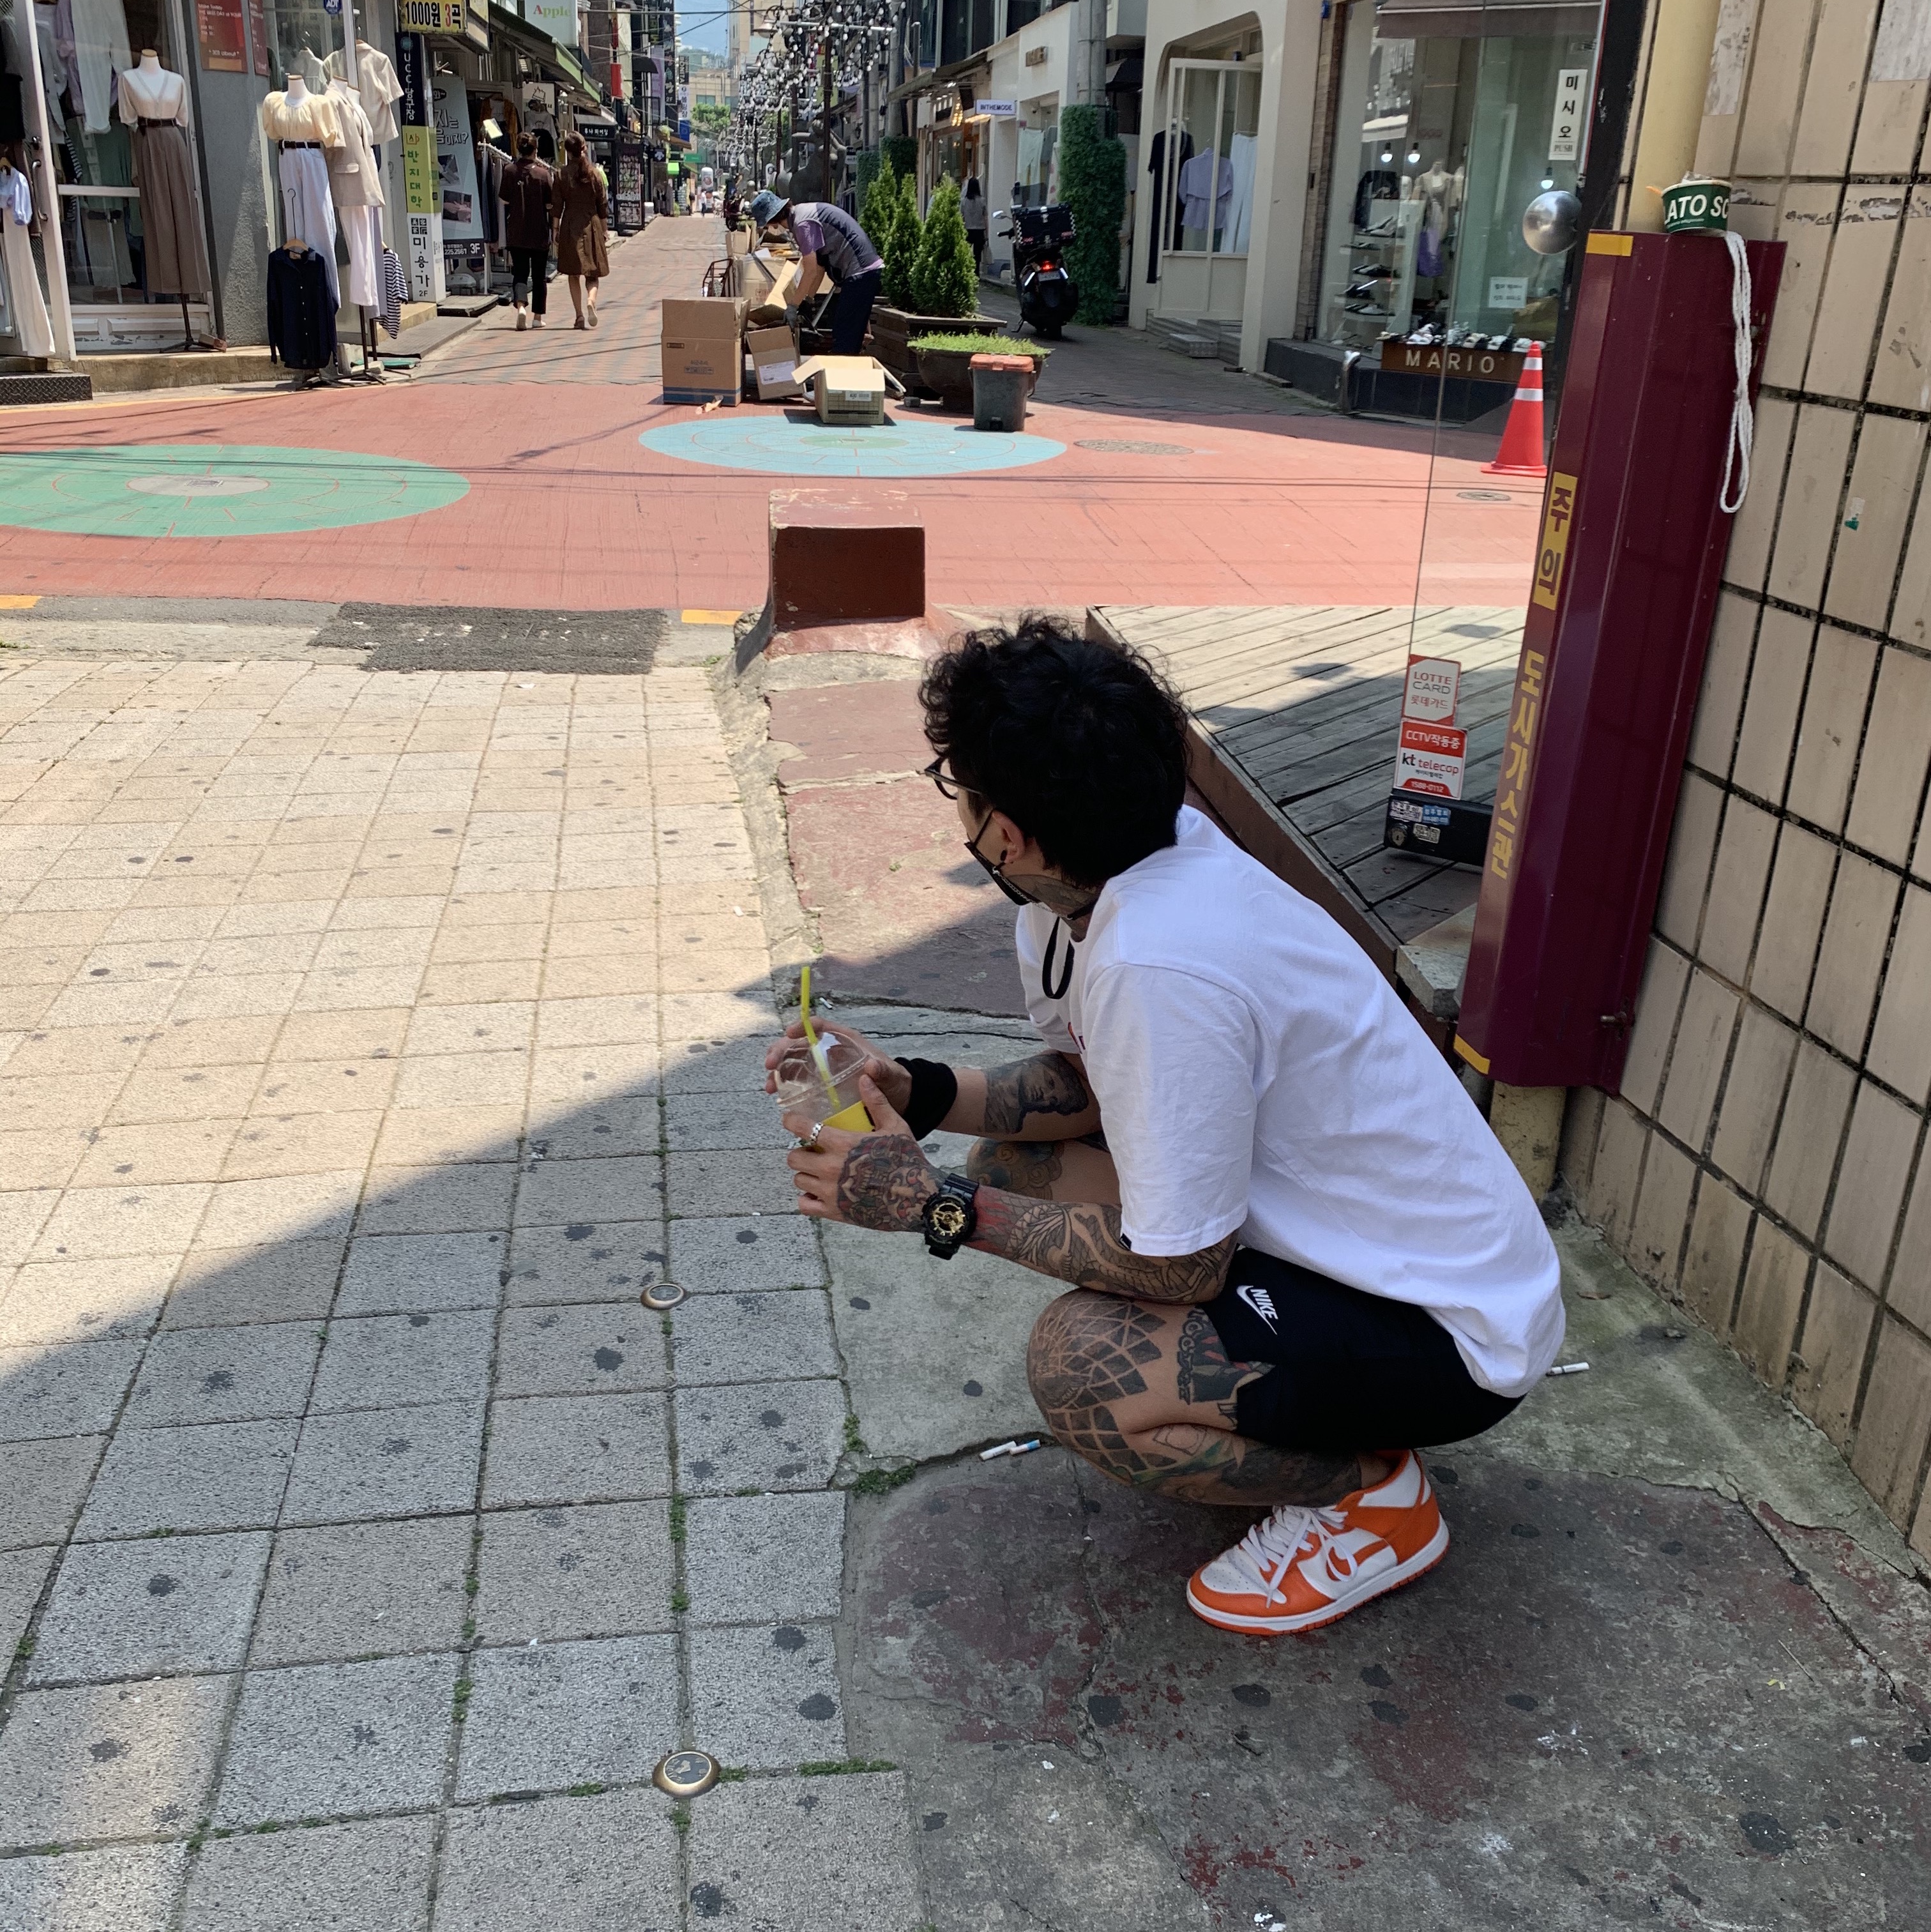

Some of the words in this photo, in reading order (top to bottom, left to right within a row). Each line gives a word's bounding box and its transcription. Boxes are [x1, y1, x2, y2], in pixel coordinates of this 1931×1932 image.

[405, 1, 441, 27] 1000원
[533, 4, 571, 18] Apple
[1558, 75, 1579, 139] 미시오
[407, 150, 422, 208] 반지대학
[470, 243, 480, 254] 3F
[1405, 349, 1495, 374] MARIO
[1412, 681, 1451, 694] CARD
[1413, 671, 1452, 685] LOTTE
[1410, 694, 1449, 710] 롯데카드
[1405, 730, 1461, 749] CCTV작동중
[1402, 753, 1416, 766] kt
[1418, 759, 1459, 776] telecop
[1491, 649, 1545, 880] 도시가스관
[1250, 1289, 1278, 1320] NIKE
